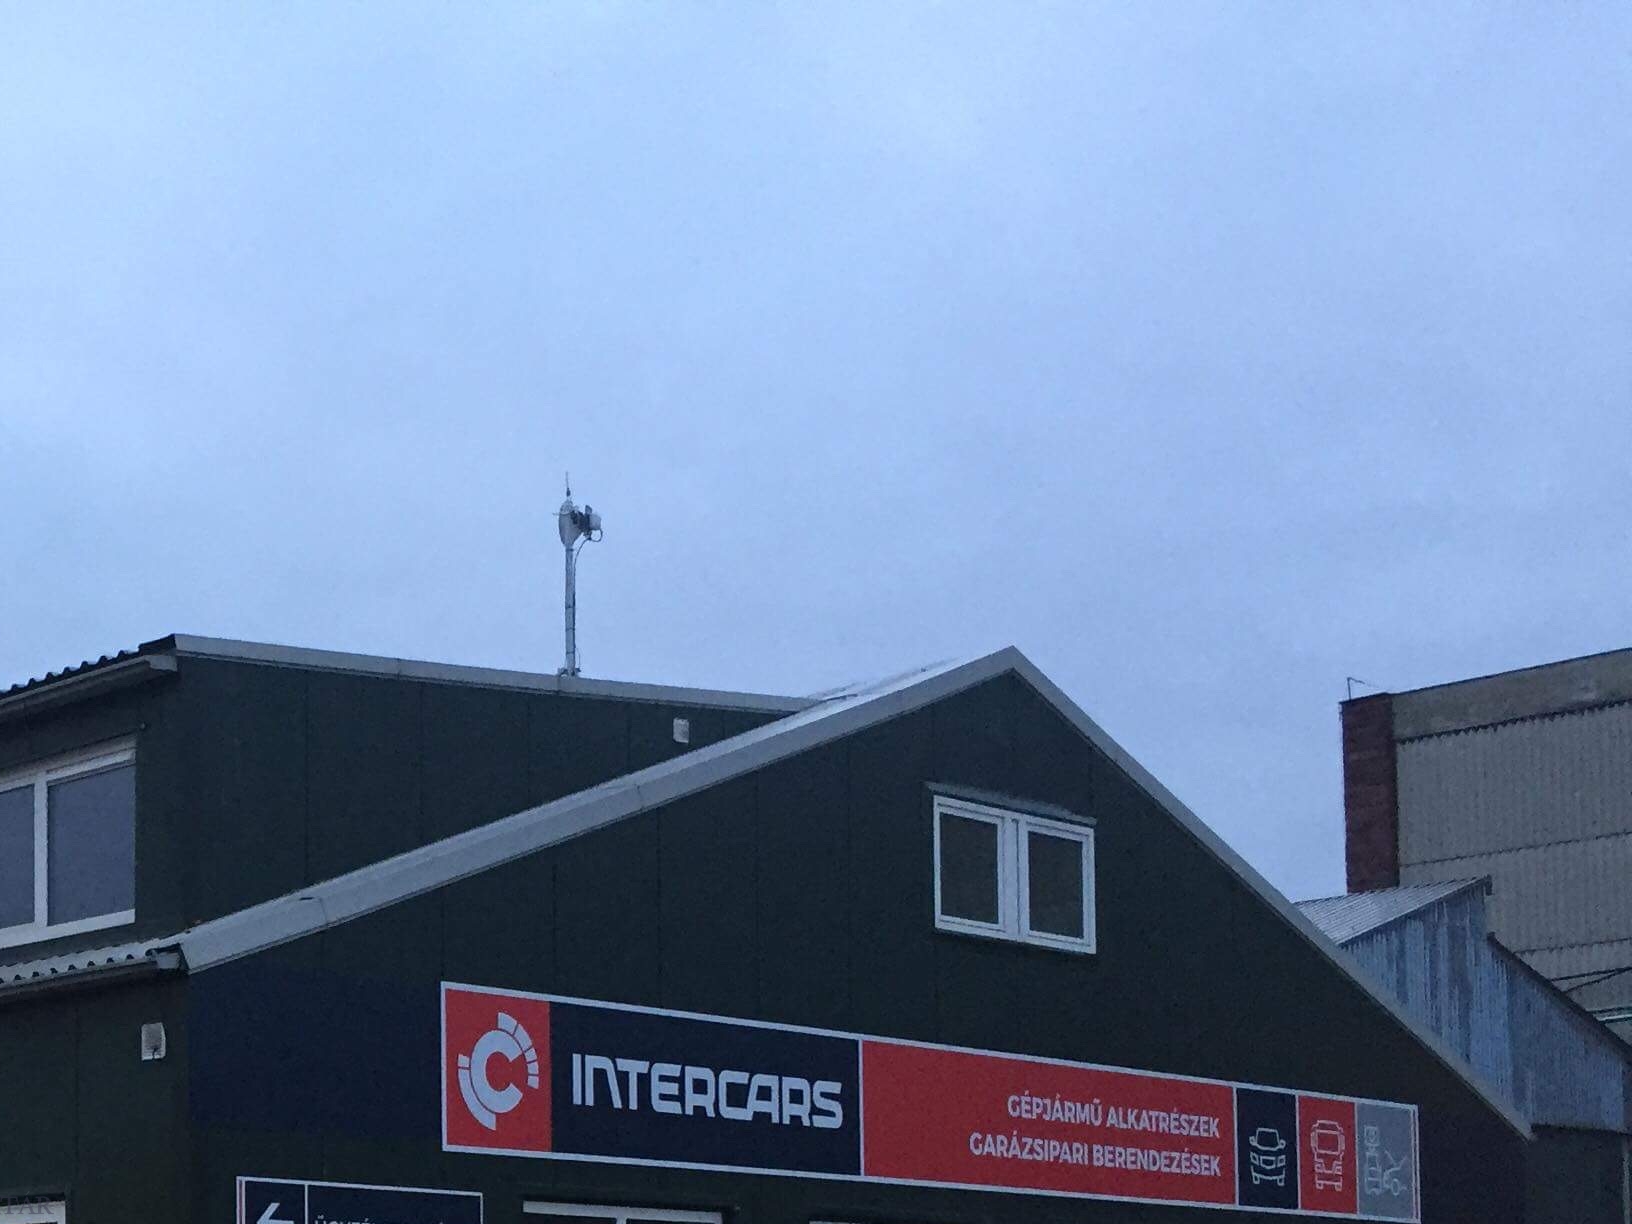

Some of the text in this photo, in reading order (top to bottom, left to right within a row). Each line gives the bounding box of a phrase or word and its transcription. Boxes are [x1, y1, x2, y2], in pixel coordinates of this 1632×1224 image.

[572, 1053, 844, 1129] INTERCARS
[1007, 1090, 1220, 1137] GÉPJÁRMŰ ALKATRÉSZEK
[969, 1130, 1221, 1177] GARÁZSIPARI BERENDEZÉSEK
